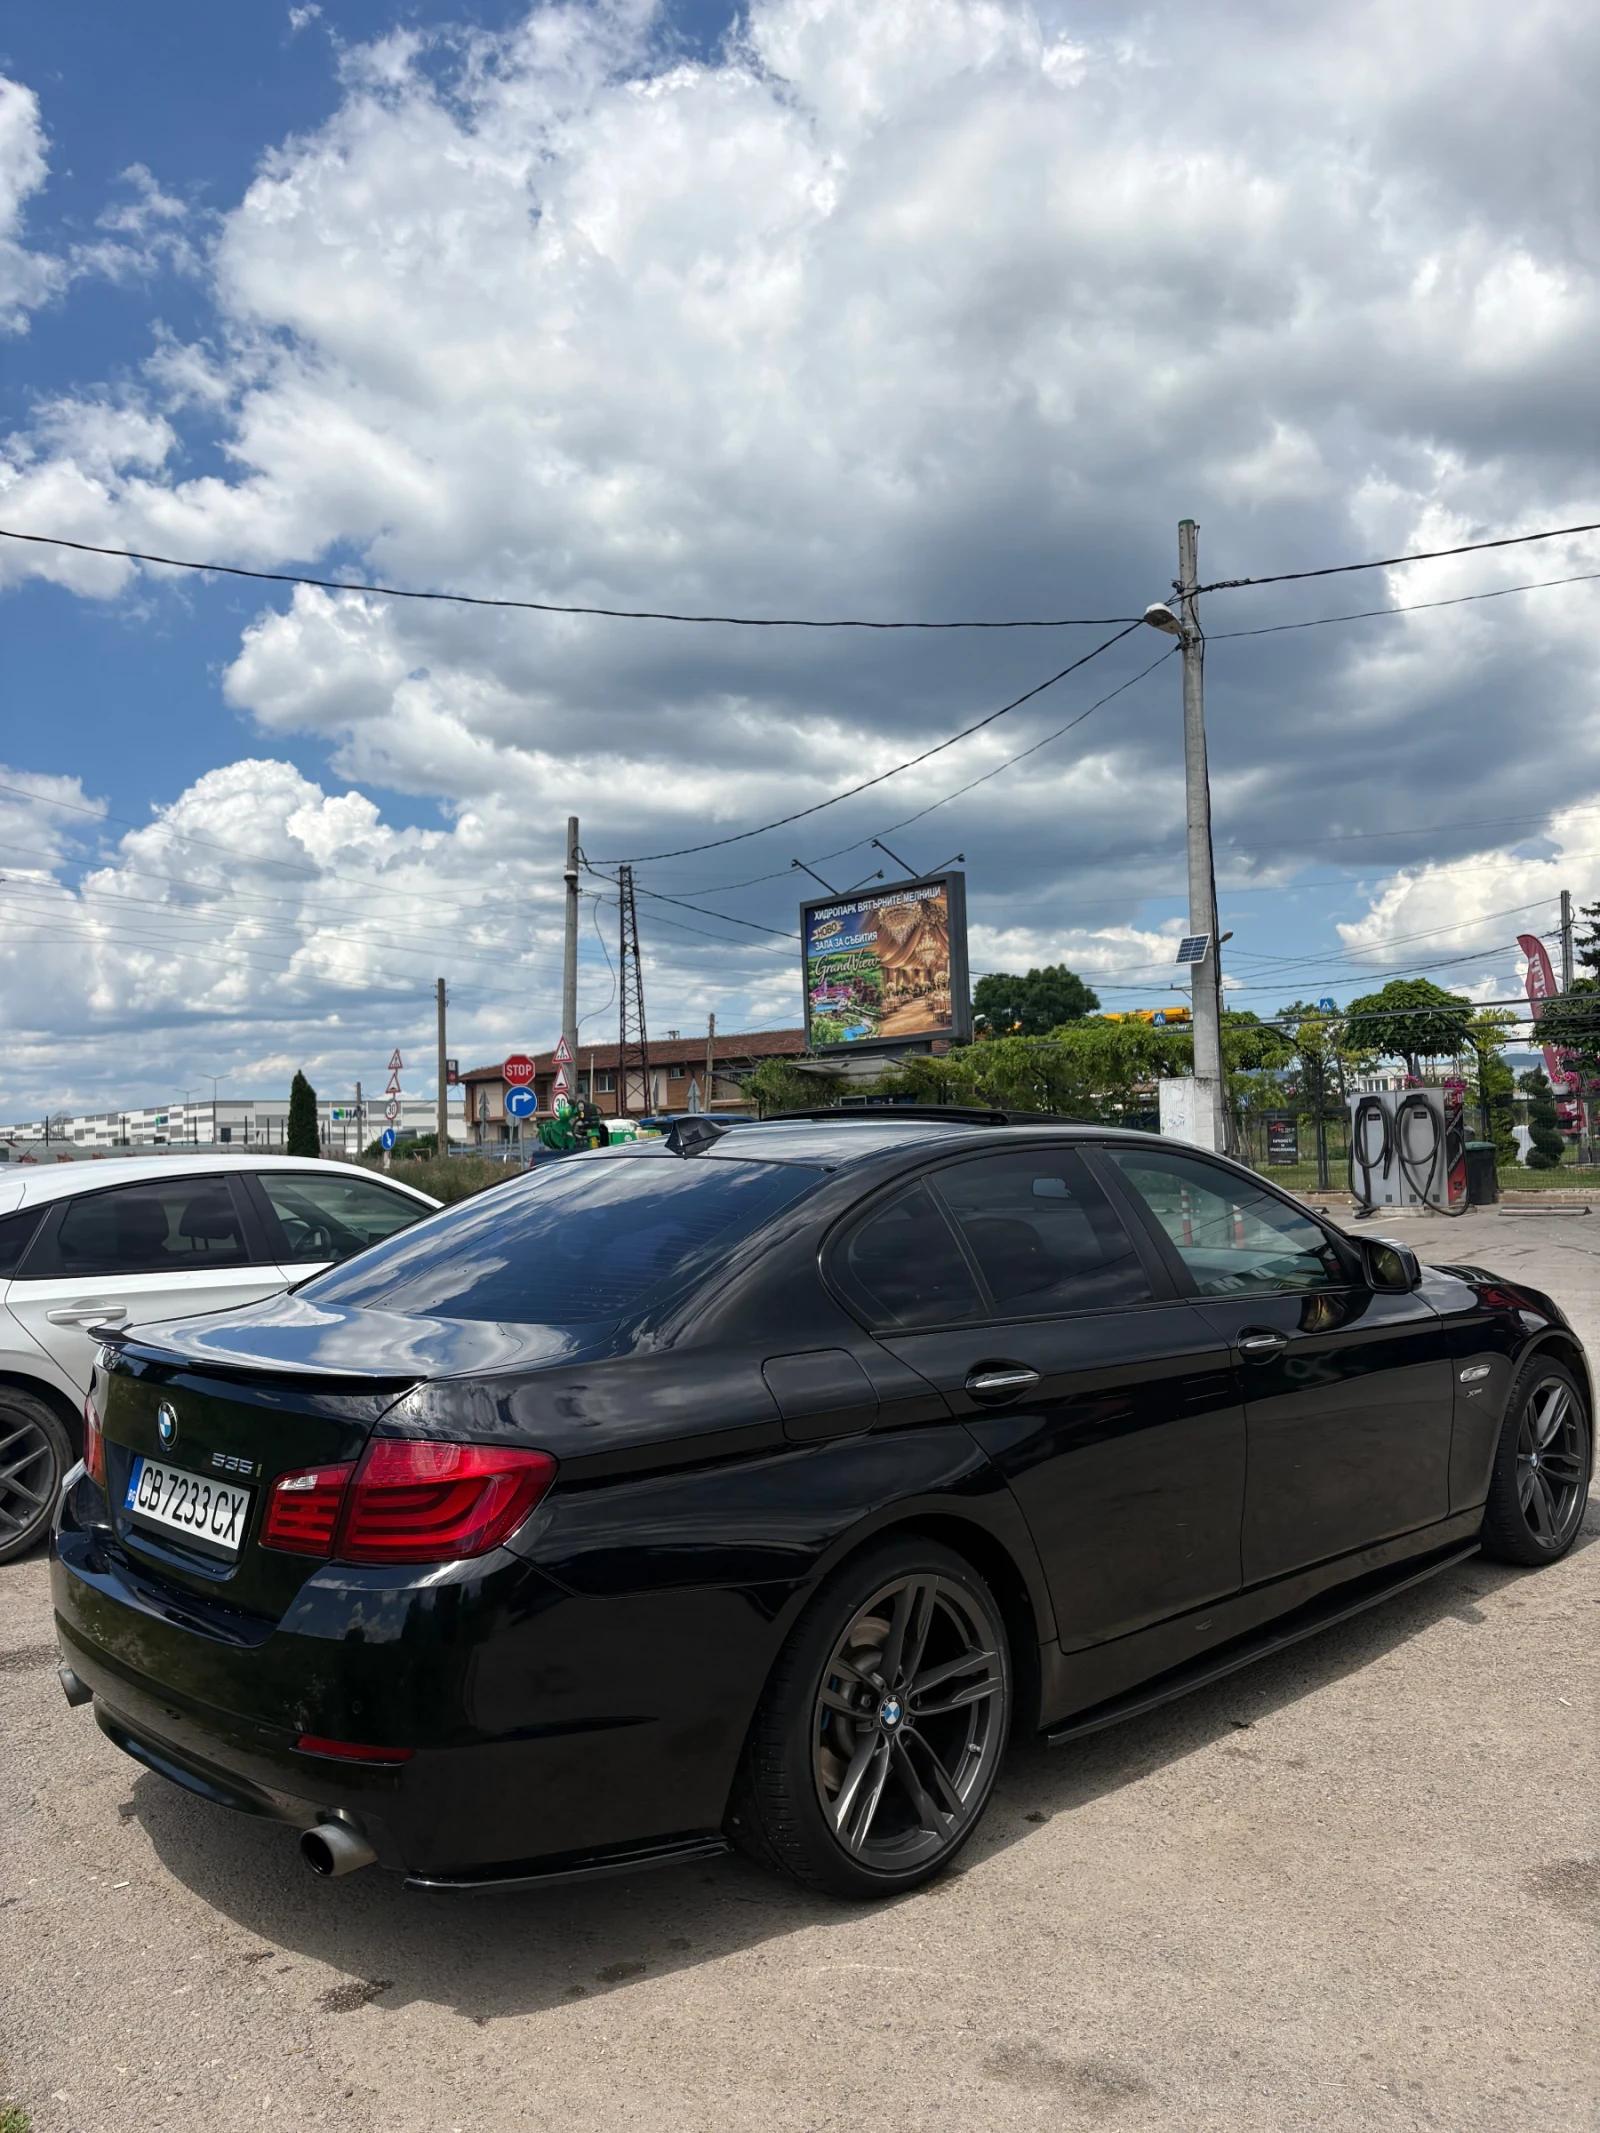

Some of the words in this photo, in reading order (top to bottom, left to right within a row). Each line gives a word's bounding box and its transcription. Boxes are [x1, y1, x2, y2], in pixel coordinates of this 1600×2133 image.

[814, 903, 857, 921] ХИДРОПАРК
[857, 896, 902, 913] ВЯТЪРНИТЕ
[903, 886, 941, 903] МЕЛНИЦИ
[817, 922, 838, 937] НОВО
[815, 940, 833, 951] ЗАЛА
[834, 938, 844, 948] ЗА
[845, 931, 878, 946] СЪБИТИЯ
[506, 1064, 532, 1077] STOP
[386, 1103, 396, 1116] 30
[556, 1098, 567, 1113] 30
[161, 1474, 211, 1529] 7233
